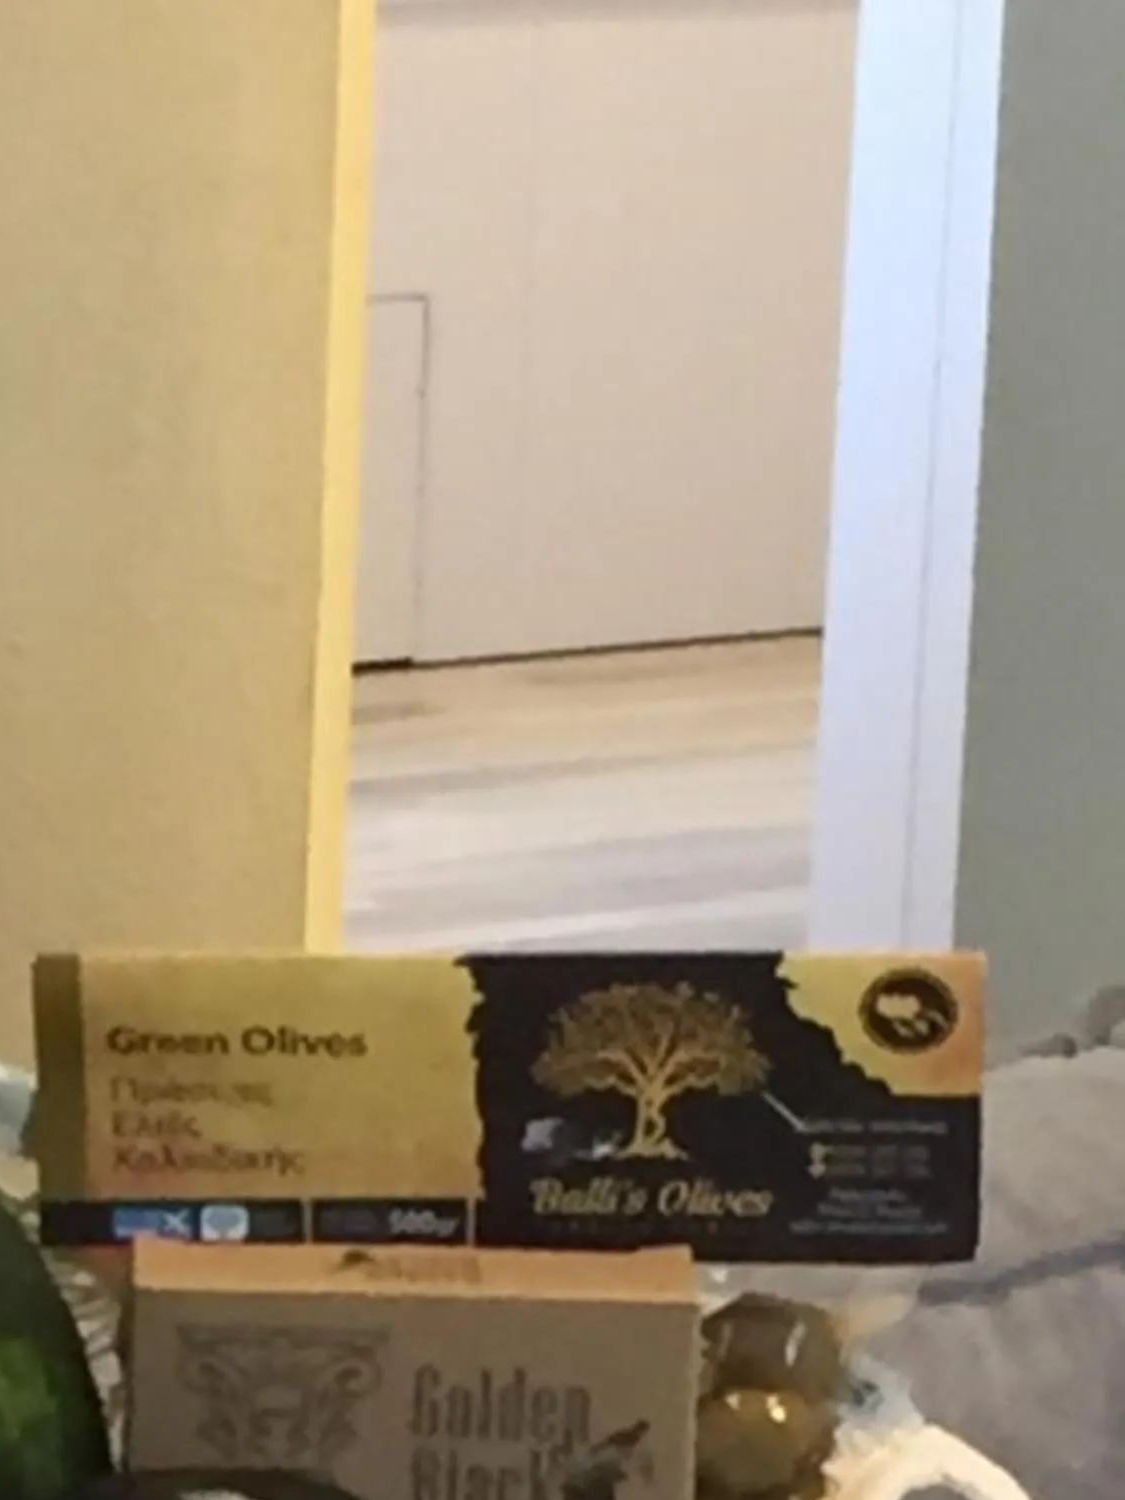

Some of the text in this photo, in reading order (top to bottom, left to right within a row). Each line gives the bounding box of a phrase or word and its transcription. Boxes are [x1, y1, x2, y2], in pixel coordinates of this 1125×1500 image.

[106, 1025, 369, 1058] Green Olives
[658, 1180, 774, 1218] Olives
[409, 1363, 592, 1452] Golden
